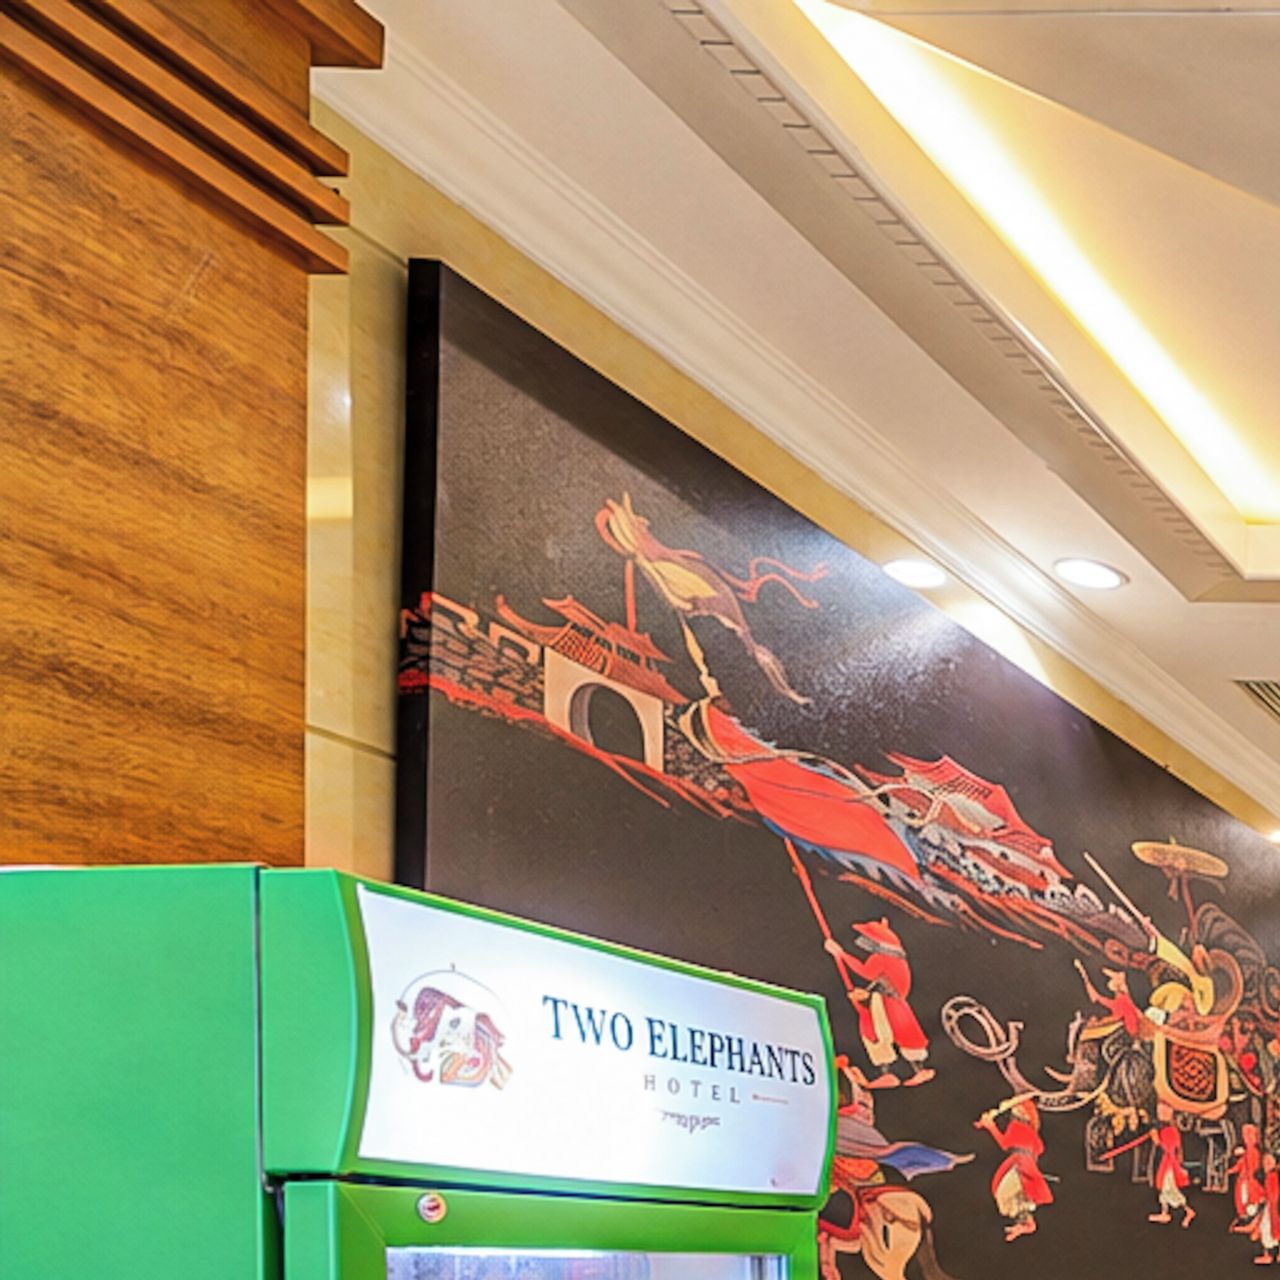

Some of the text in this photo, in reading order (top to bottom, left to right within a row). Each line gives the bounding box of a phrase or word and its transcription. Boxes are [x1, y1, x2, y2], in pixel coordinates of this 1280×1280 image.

[542, 994, 815, 1086] TWO ELEPHANTS
[643, 1074, 741, 1104] HOTEL
